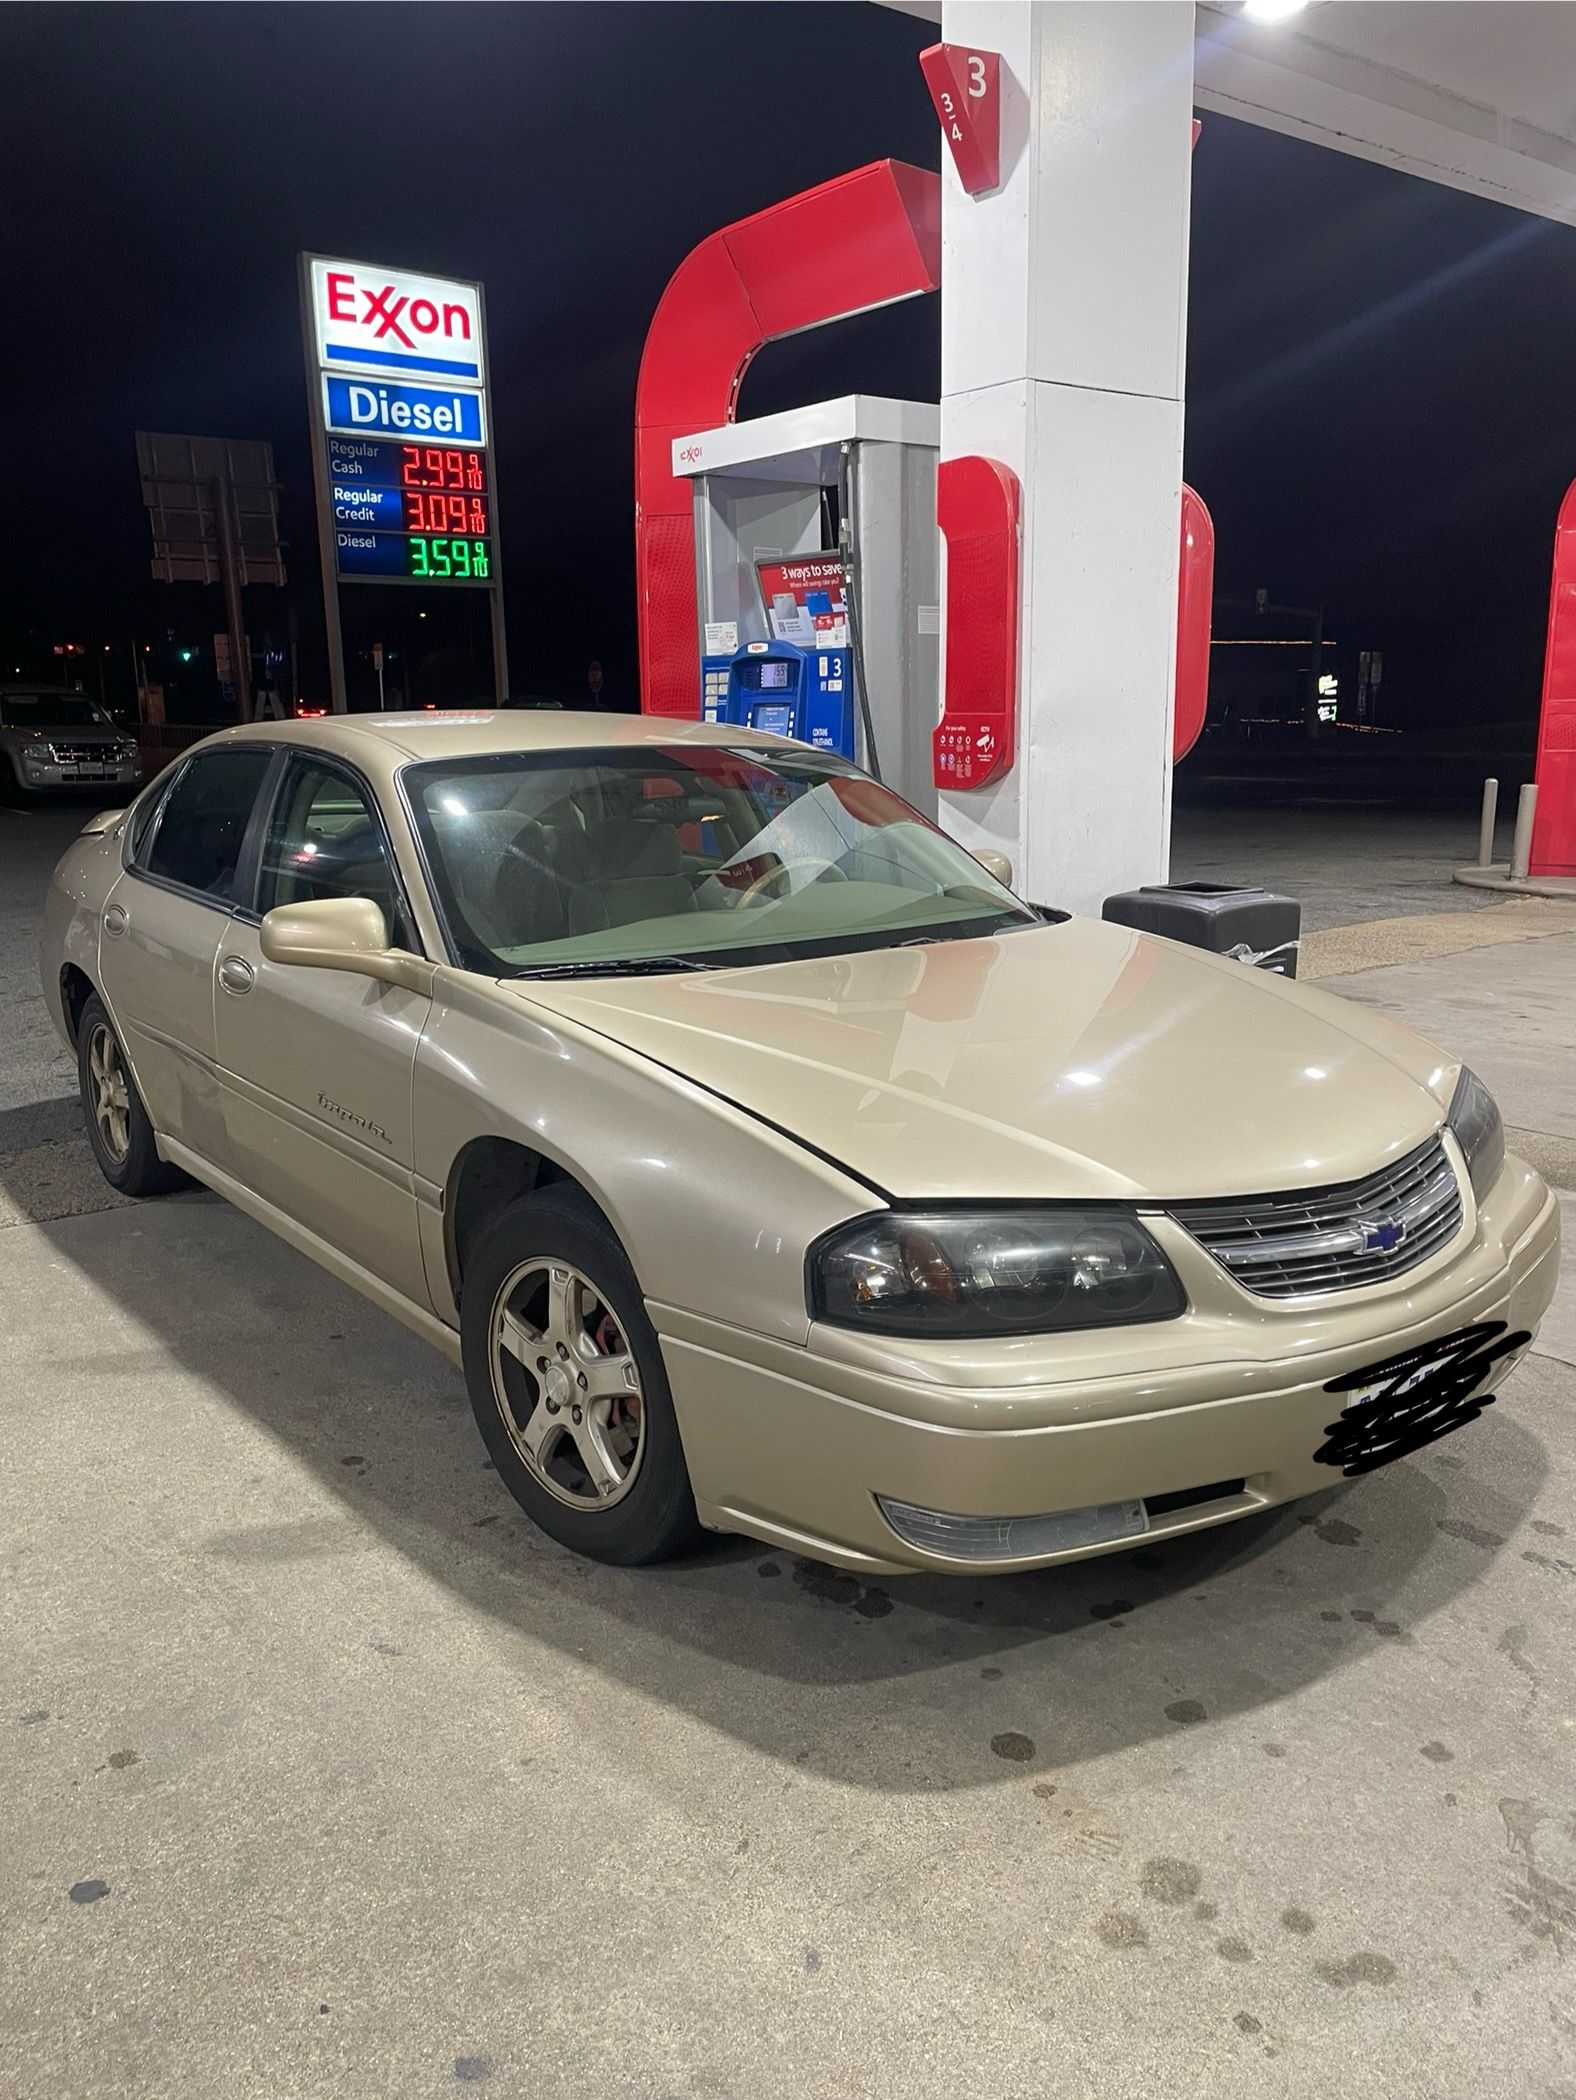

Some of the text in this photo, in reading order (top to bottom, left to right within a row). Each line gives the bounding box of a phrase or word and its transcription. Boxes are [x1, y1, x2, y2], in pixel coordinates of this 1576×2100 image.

[968, 56, 987, 98] 3
[326, 272, 471, 350] Exxon
[349, 386, 463, 433] Diesel
[330, 440, 379, 459] Regular
[331, 459, 363, 475] Cash
[403, 447, 464, 489] 2.99
[334, 487, 384, 505] Regular
[335, 506, 375, 522] Credit
[406, 492, 467, 533] 3.09
[337, 533, 376, 549] Diesel
[409, 538, 471, 577] 3.59
[781, 563, 843, 582] 3 ways to save
[833, 657, 842, 677] 3
